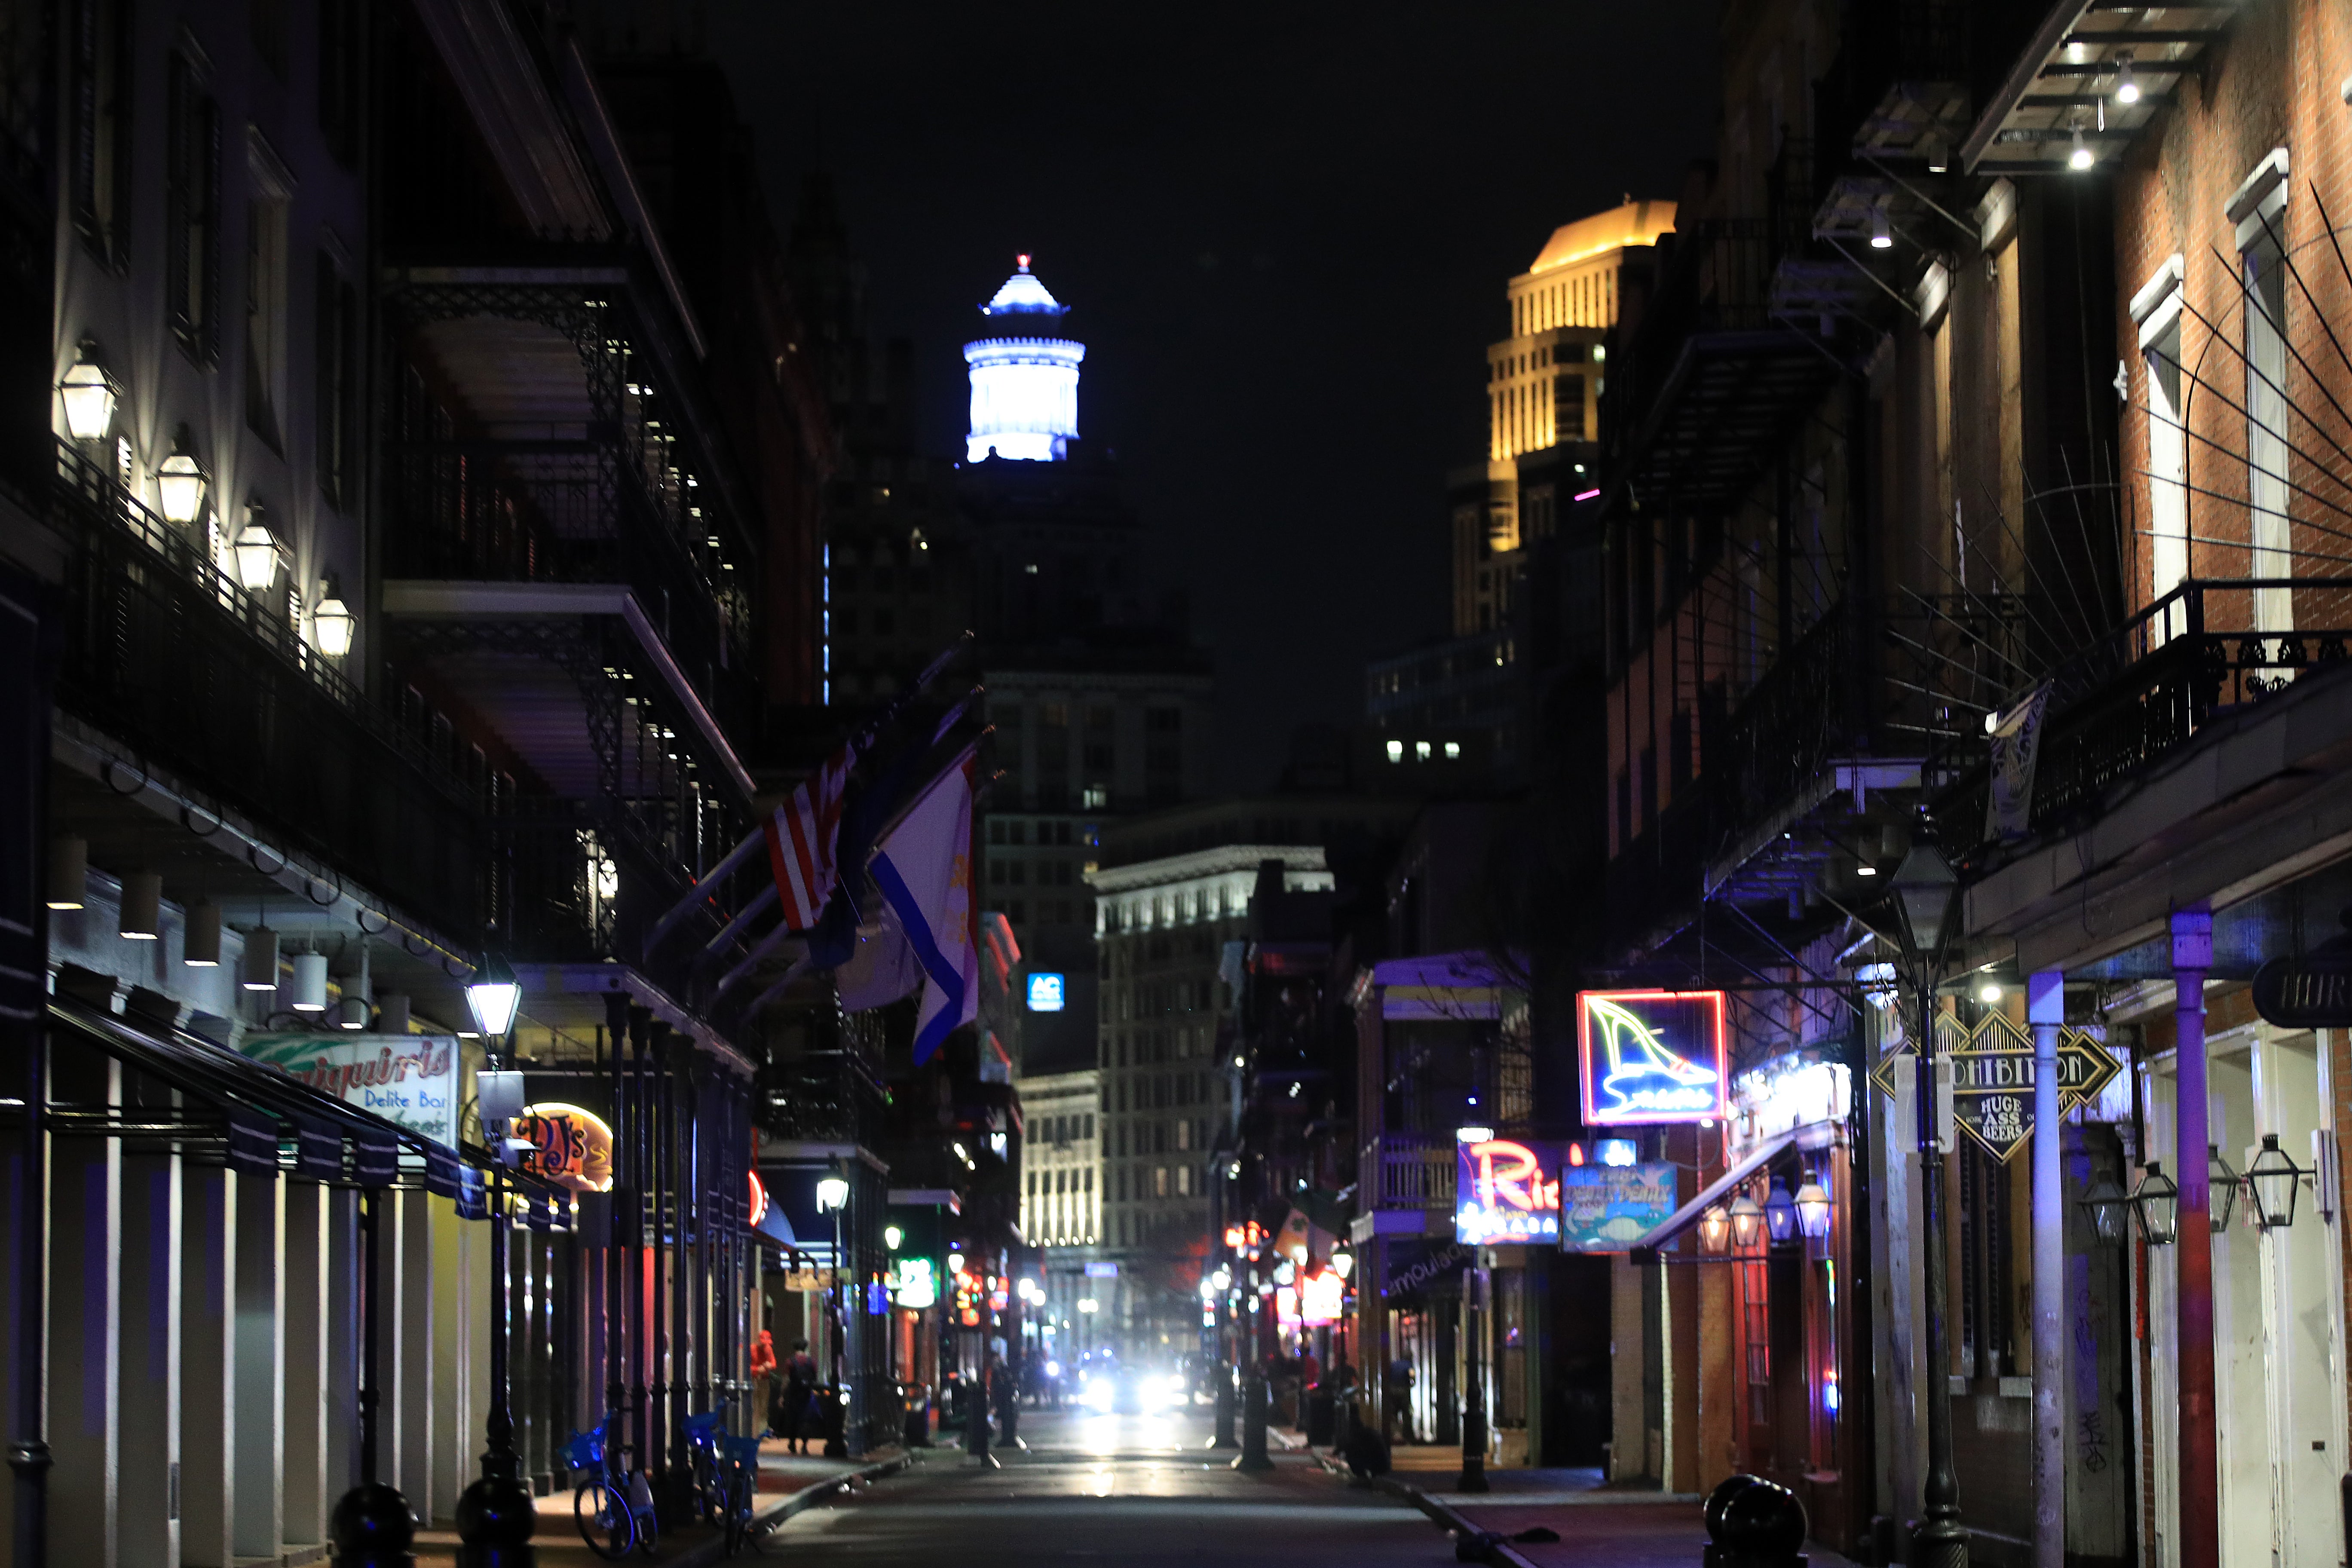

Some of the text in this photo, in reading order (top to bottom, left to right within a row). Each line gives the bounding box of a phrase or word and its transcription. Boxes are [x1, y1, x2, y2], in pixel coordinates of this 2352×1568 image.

[1953, 1055, 2082, 1087] OHIBITON
[365, 1088, 446, 1108] Delite Bar
[1981, 1095, 2022, 1114] HUGE
[1984, 1112, 2020, 1125] ASS
[1982, 1124, 2023, 1142] BEERS
